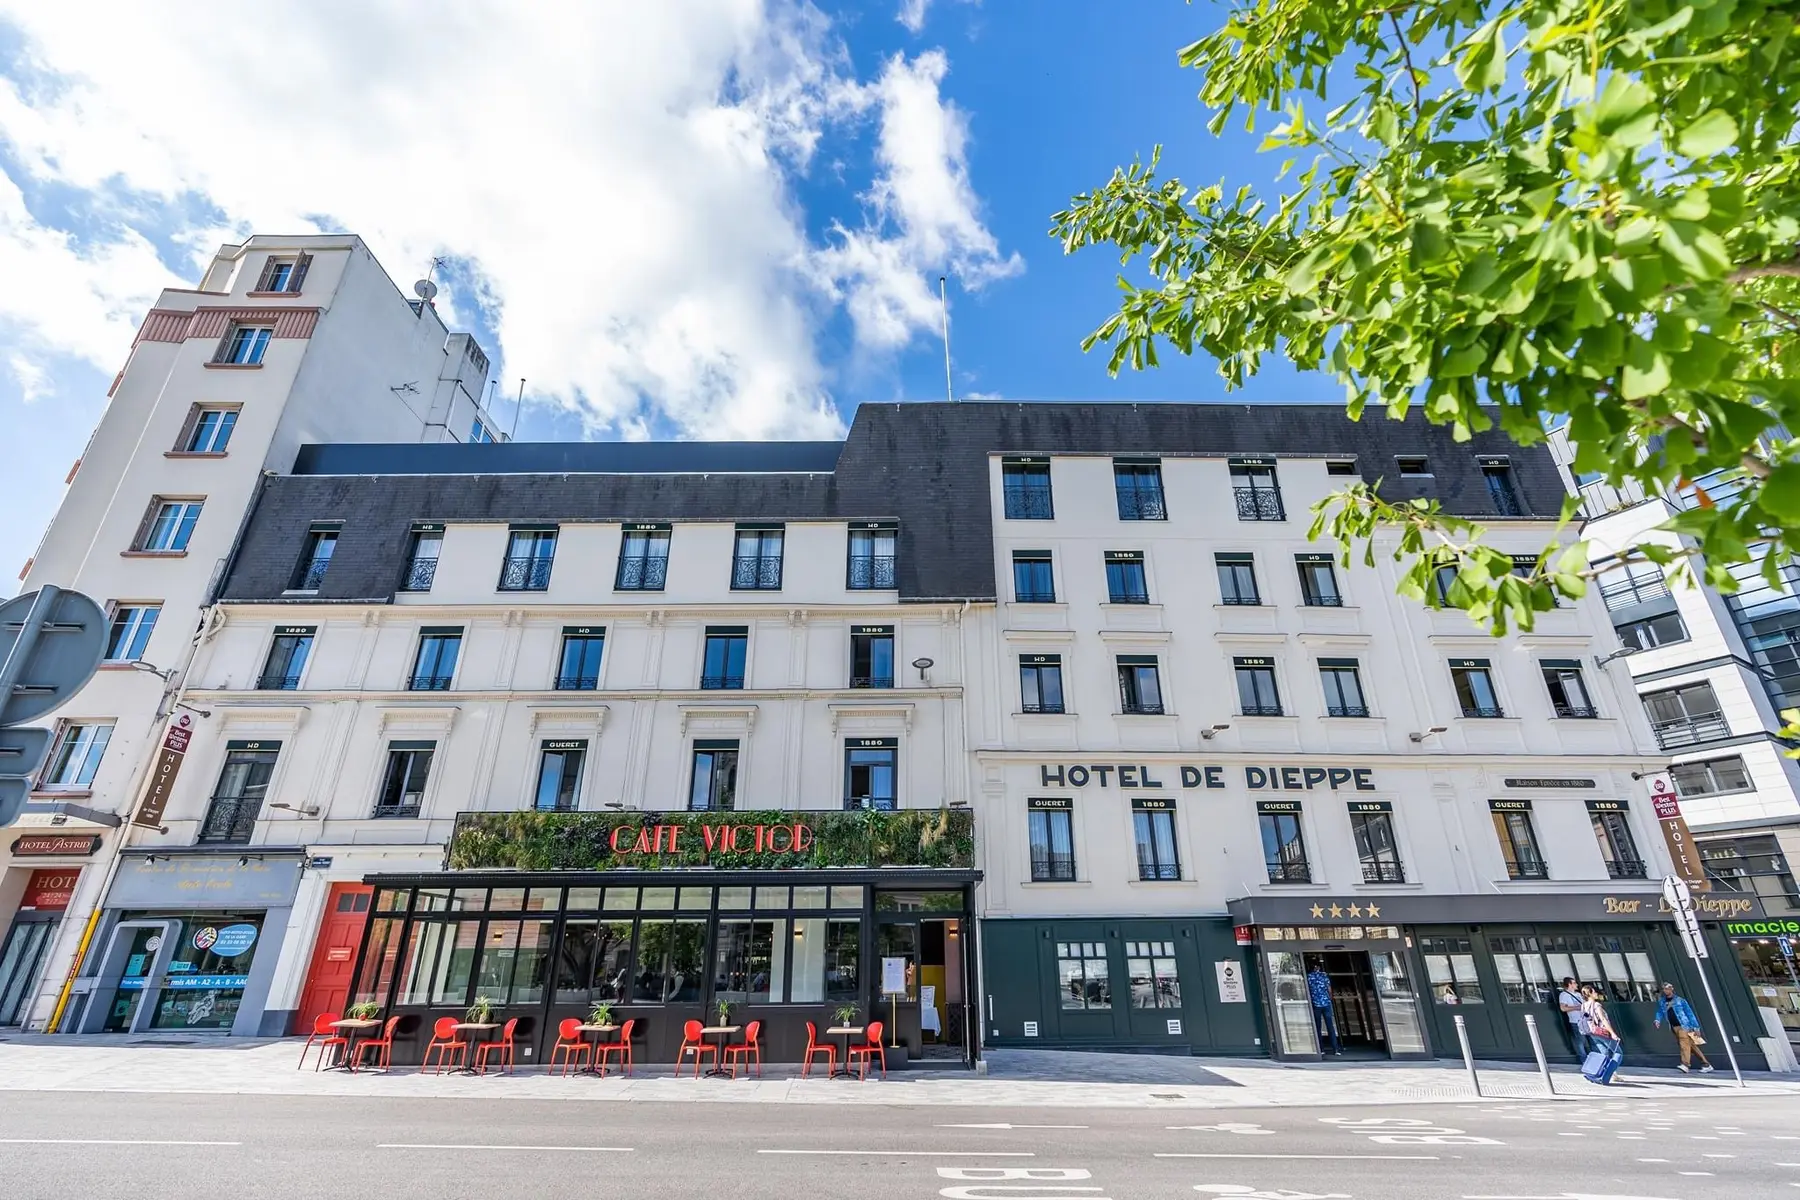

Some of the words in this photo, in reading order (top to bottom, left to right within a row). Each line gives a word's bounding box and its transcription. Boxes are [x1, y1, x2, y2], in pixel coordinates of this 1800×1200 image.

[152, 754, 175, 805] HOTEL
[1041, 764, 1162, 788] HOTEL
[1180, 766, 1226, 788] DE
[1246, 767, 1377, 790] DIEPPE
[20, 841, 51, 849] HOTEL
[47, 838, 90, 852] ASTRID
[609, 824, 686, 854] CAFE
[702, 824, 813, 855] VICTOR
[1669, 821, 1692, 876] HOTEL
[36, 876, 78, 889] HOT
[1603, 897, 1640, 914] Bar
